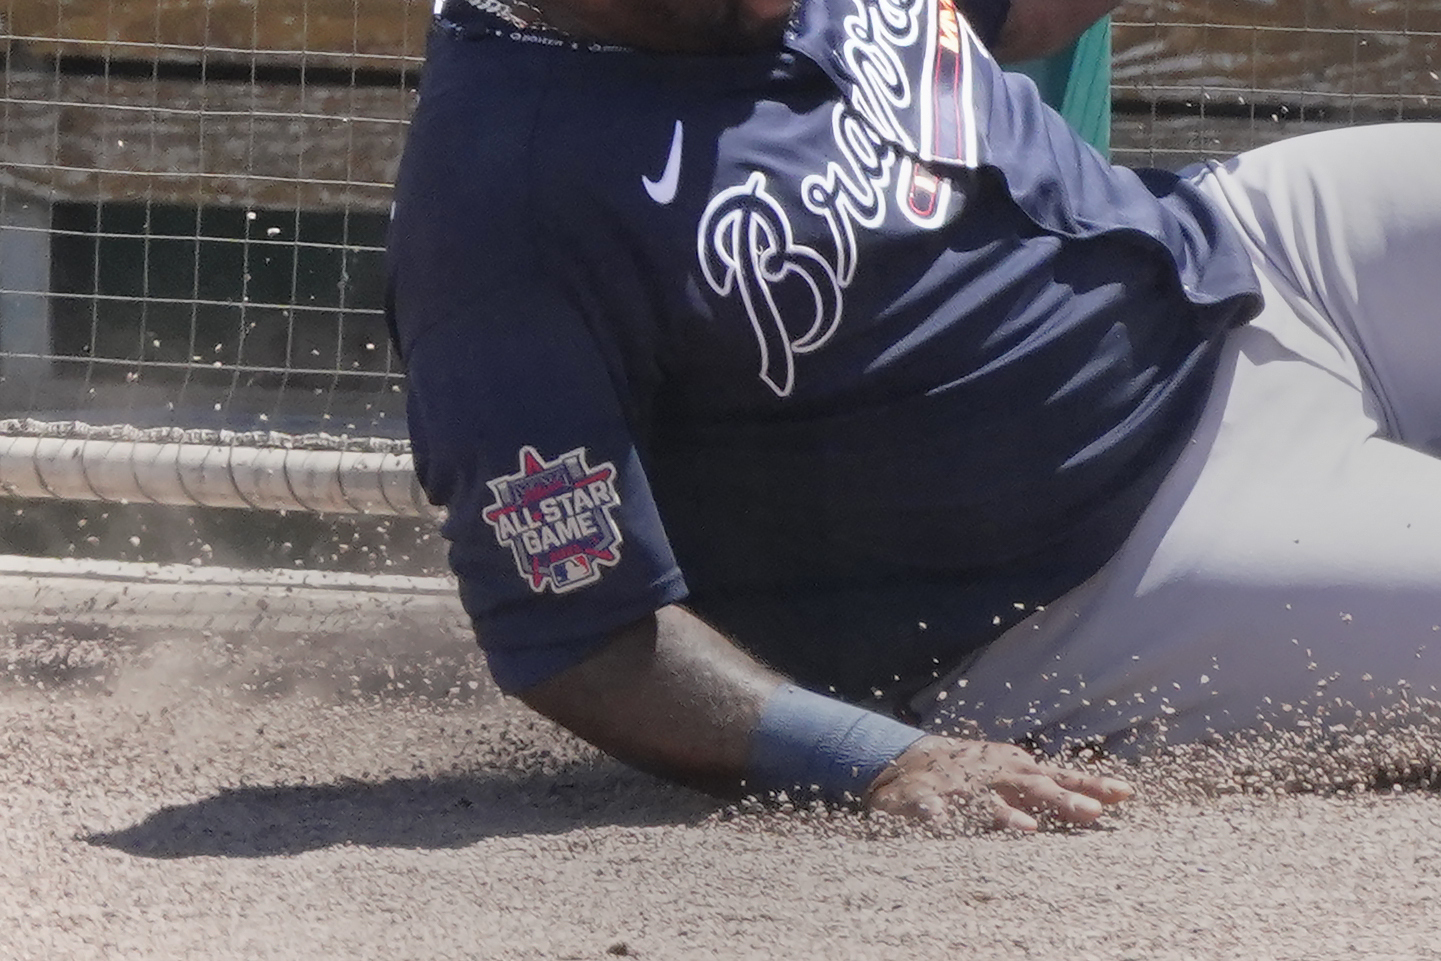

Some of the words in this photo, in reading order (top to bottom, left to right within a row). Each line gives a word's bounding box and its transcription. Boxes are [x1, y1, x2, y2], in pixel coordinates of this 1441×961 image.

[499, 507, 543, 540] ALL
[540, 480, 611, 523] STAR
[521, 511, 599, 556] GAME
